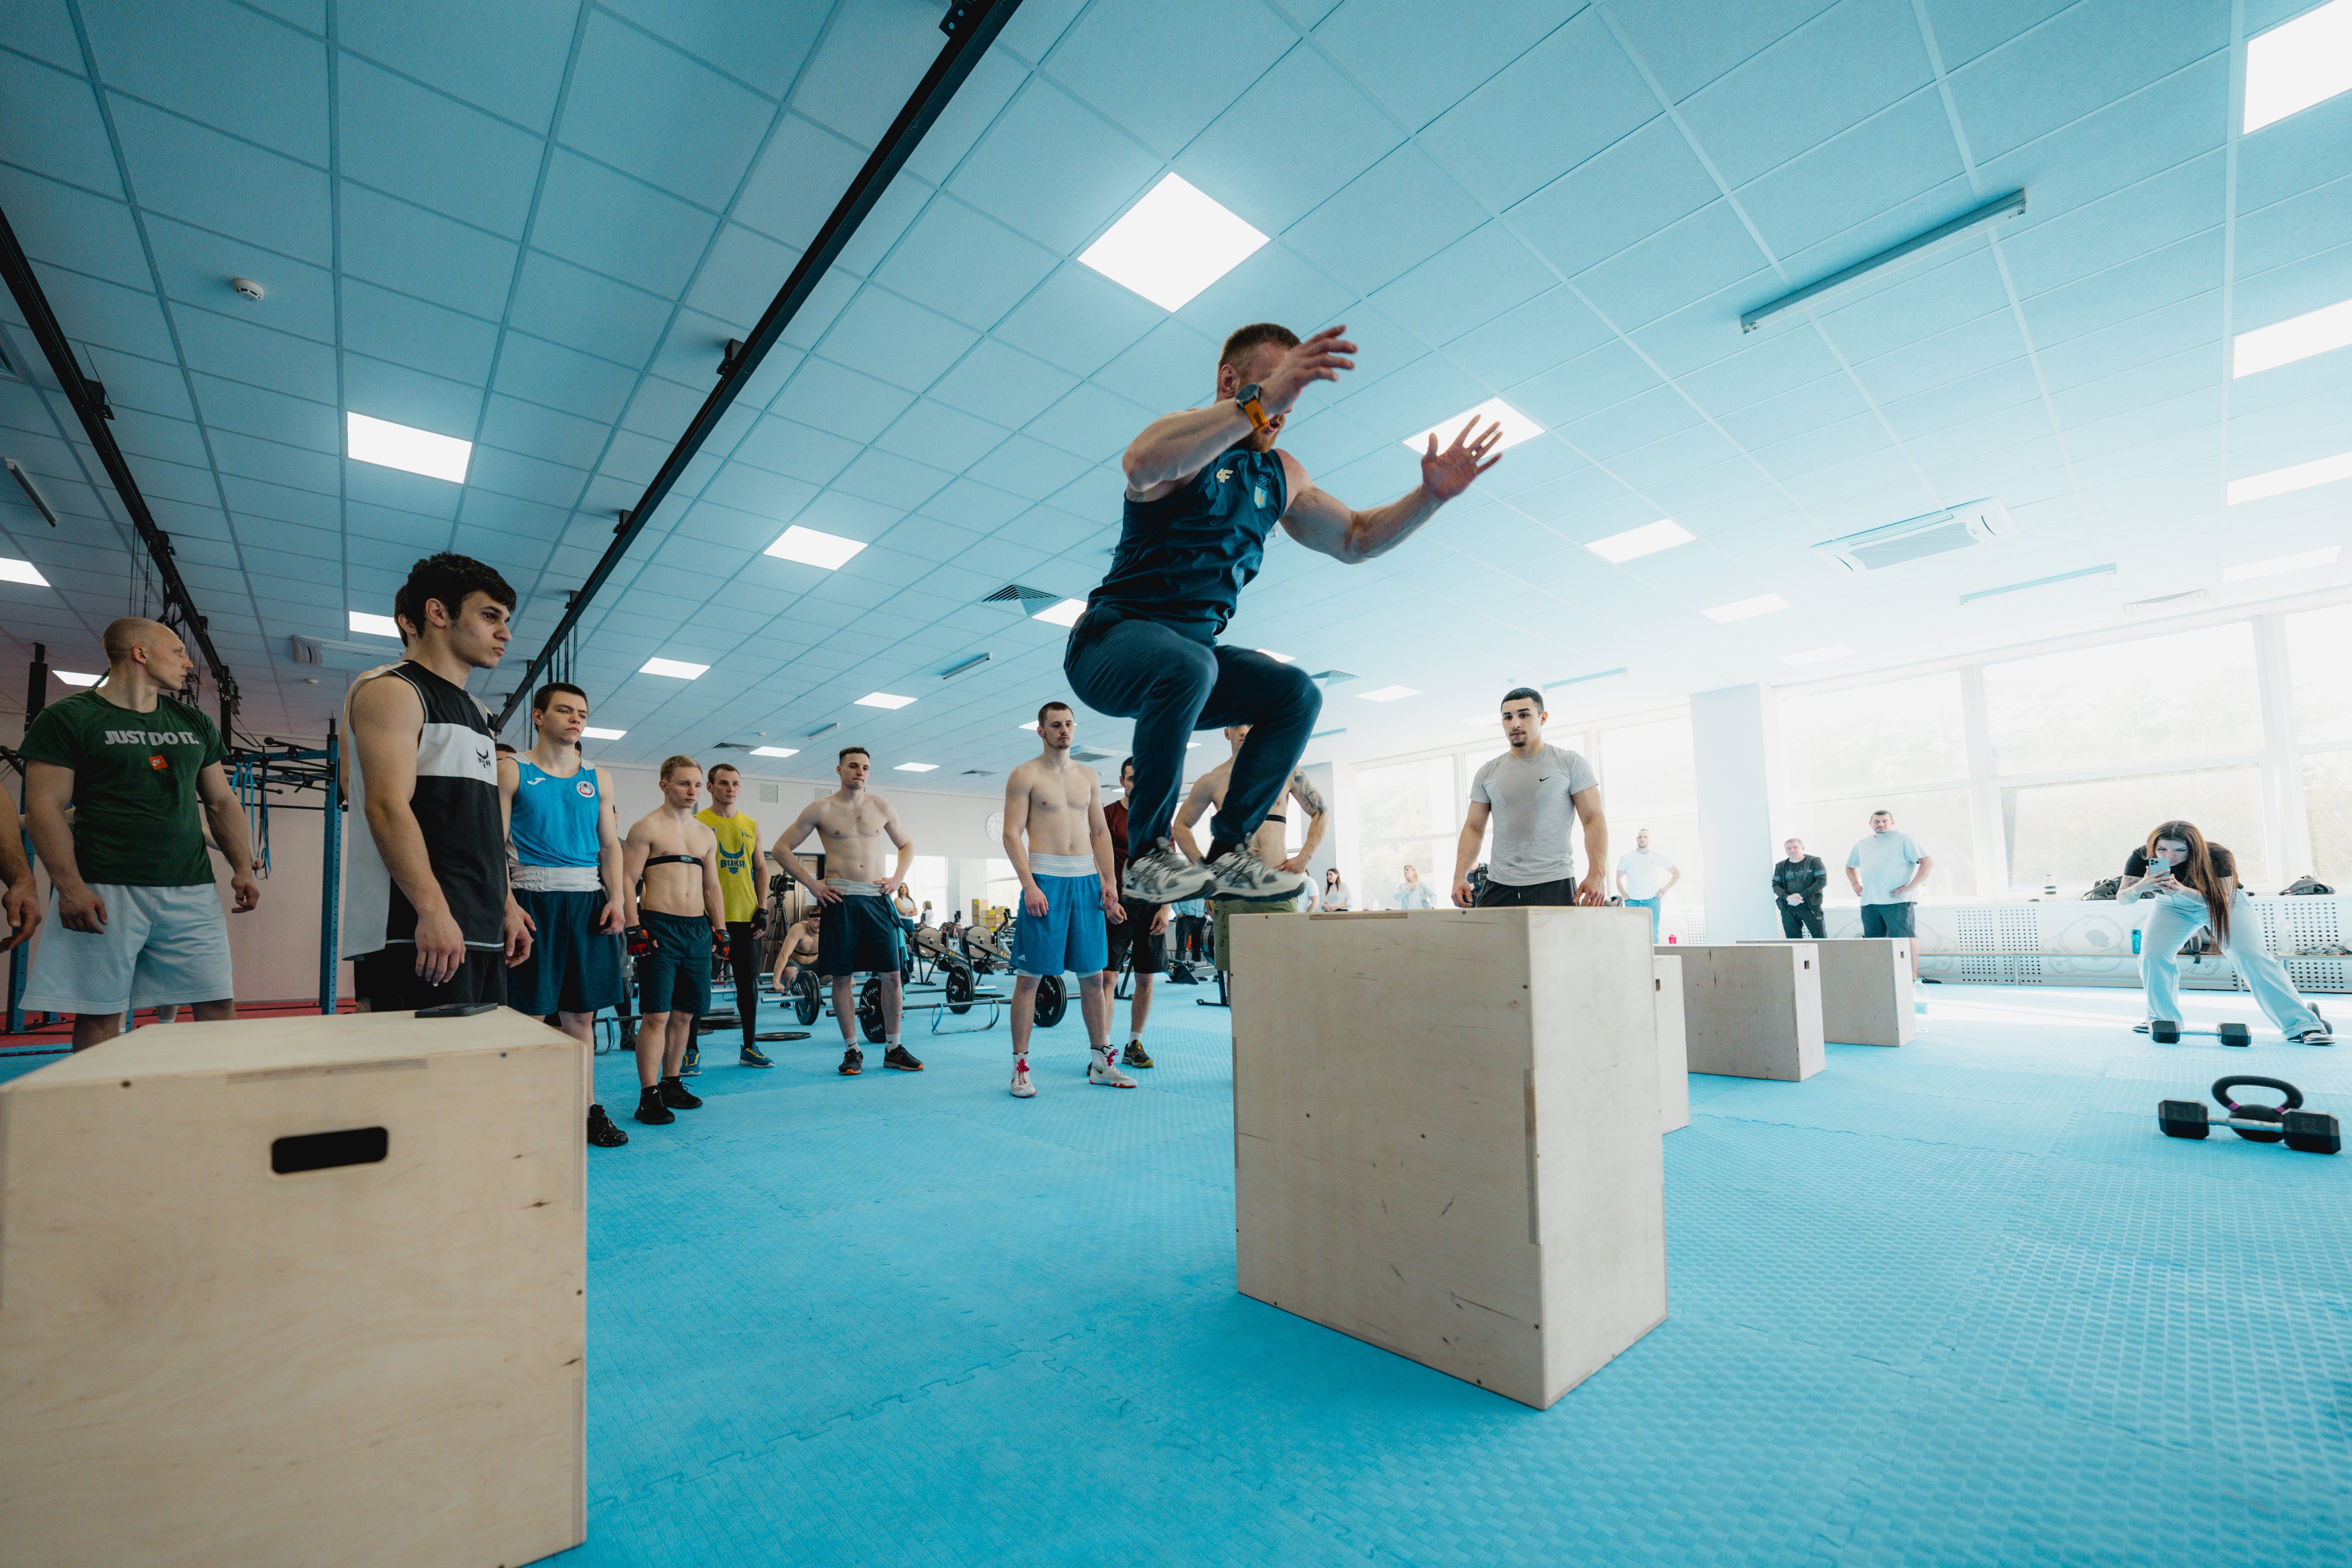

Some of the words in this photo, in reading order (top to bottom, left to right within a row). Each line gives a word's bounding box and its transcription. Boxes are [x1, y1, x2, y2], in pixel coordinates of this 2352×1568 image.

[1216, 468, 1233, 483] 4F
[105, 731, 146, 745] JUST
[148, 732, 179, 746] DO
[178, 732, 199, 744] IT.
[721, 860, 745, 869] BUKA
